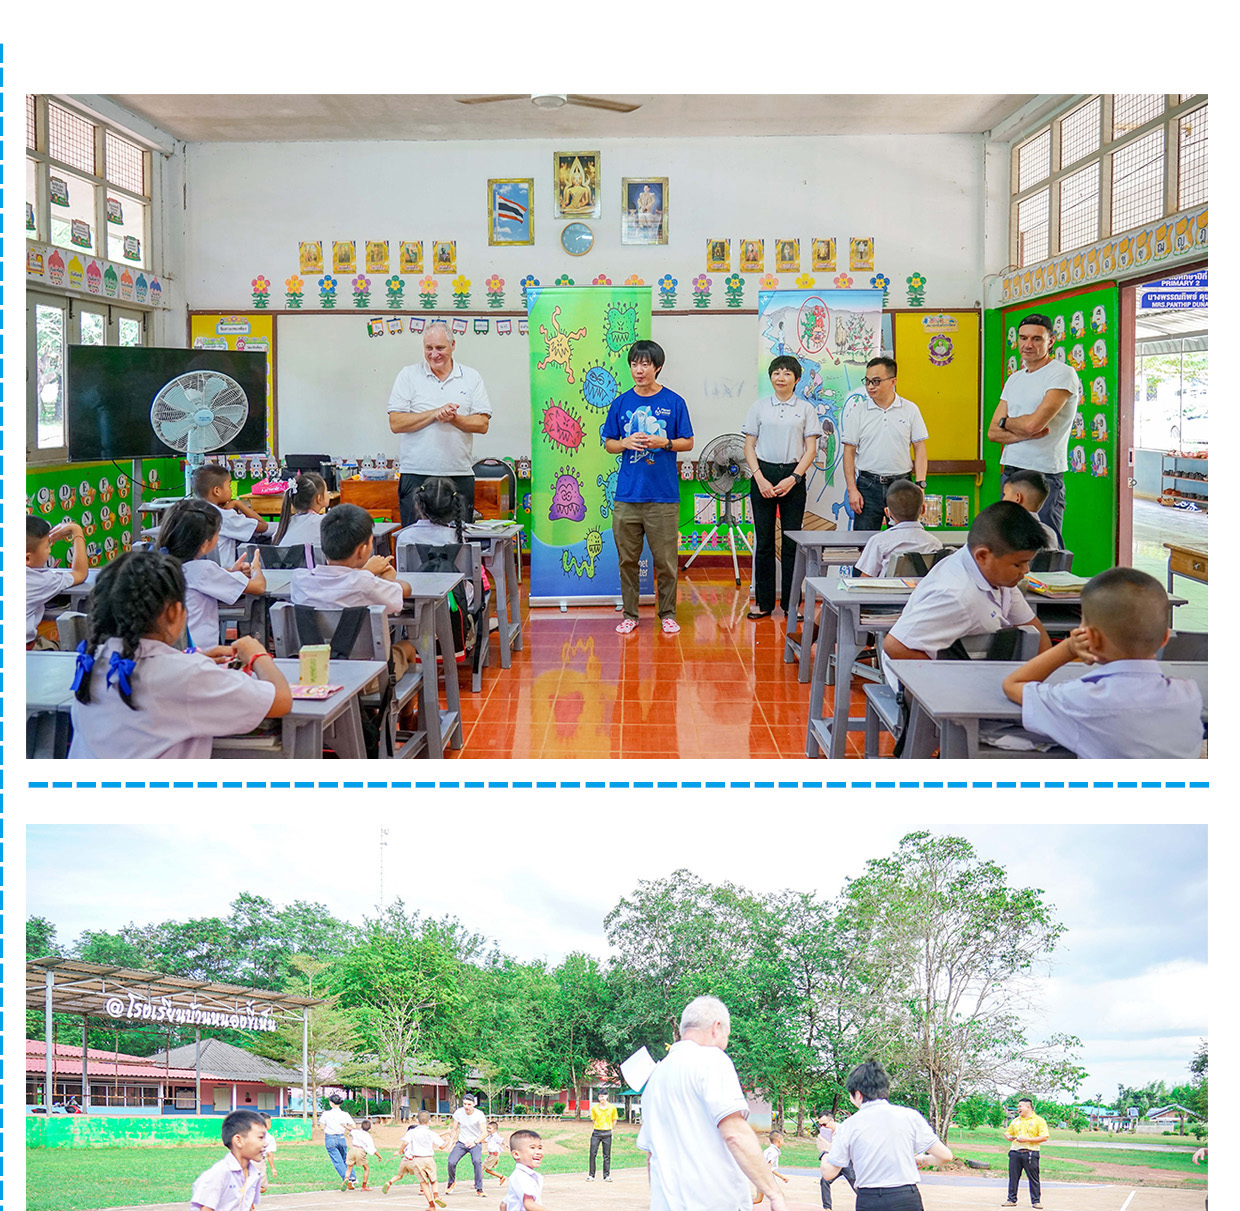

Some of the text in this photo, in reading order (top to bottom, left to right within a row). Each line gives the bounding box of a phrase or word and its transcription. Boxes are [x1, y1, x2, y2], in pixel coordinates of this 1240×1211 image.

[102, 479, 107, 489] F
[118, 475, 124, 486] G
[62, 486, 68, 497] D
[83, 482, 88, 493] E
[40, 488, 47, 500] C
[102, 507, 108, 518] O
